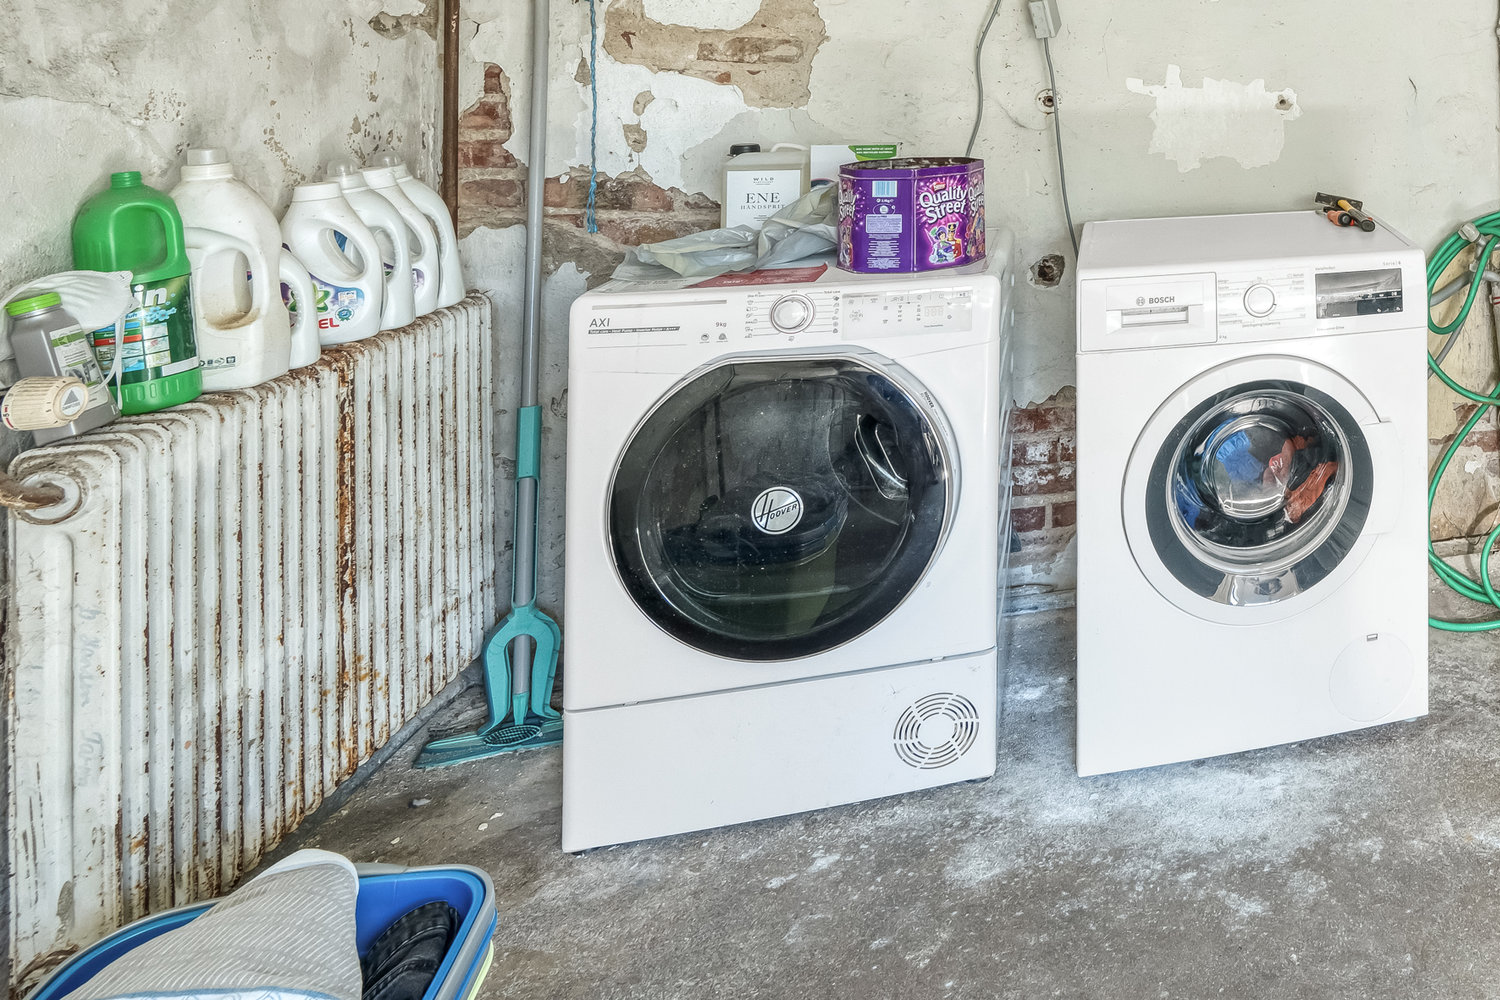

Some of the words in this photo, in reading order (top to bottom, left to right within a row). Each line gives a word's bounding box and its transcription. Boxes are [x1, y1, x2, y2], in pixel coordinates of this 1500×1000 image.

[746, 192, 780, 204] ENE
[920, 186, 967, 208] Quality
[925, 200, 966, 224] Street
[1149, 296, 1175, 304] BOSCH
[589, 318, 610, 327] AXI
